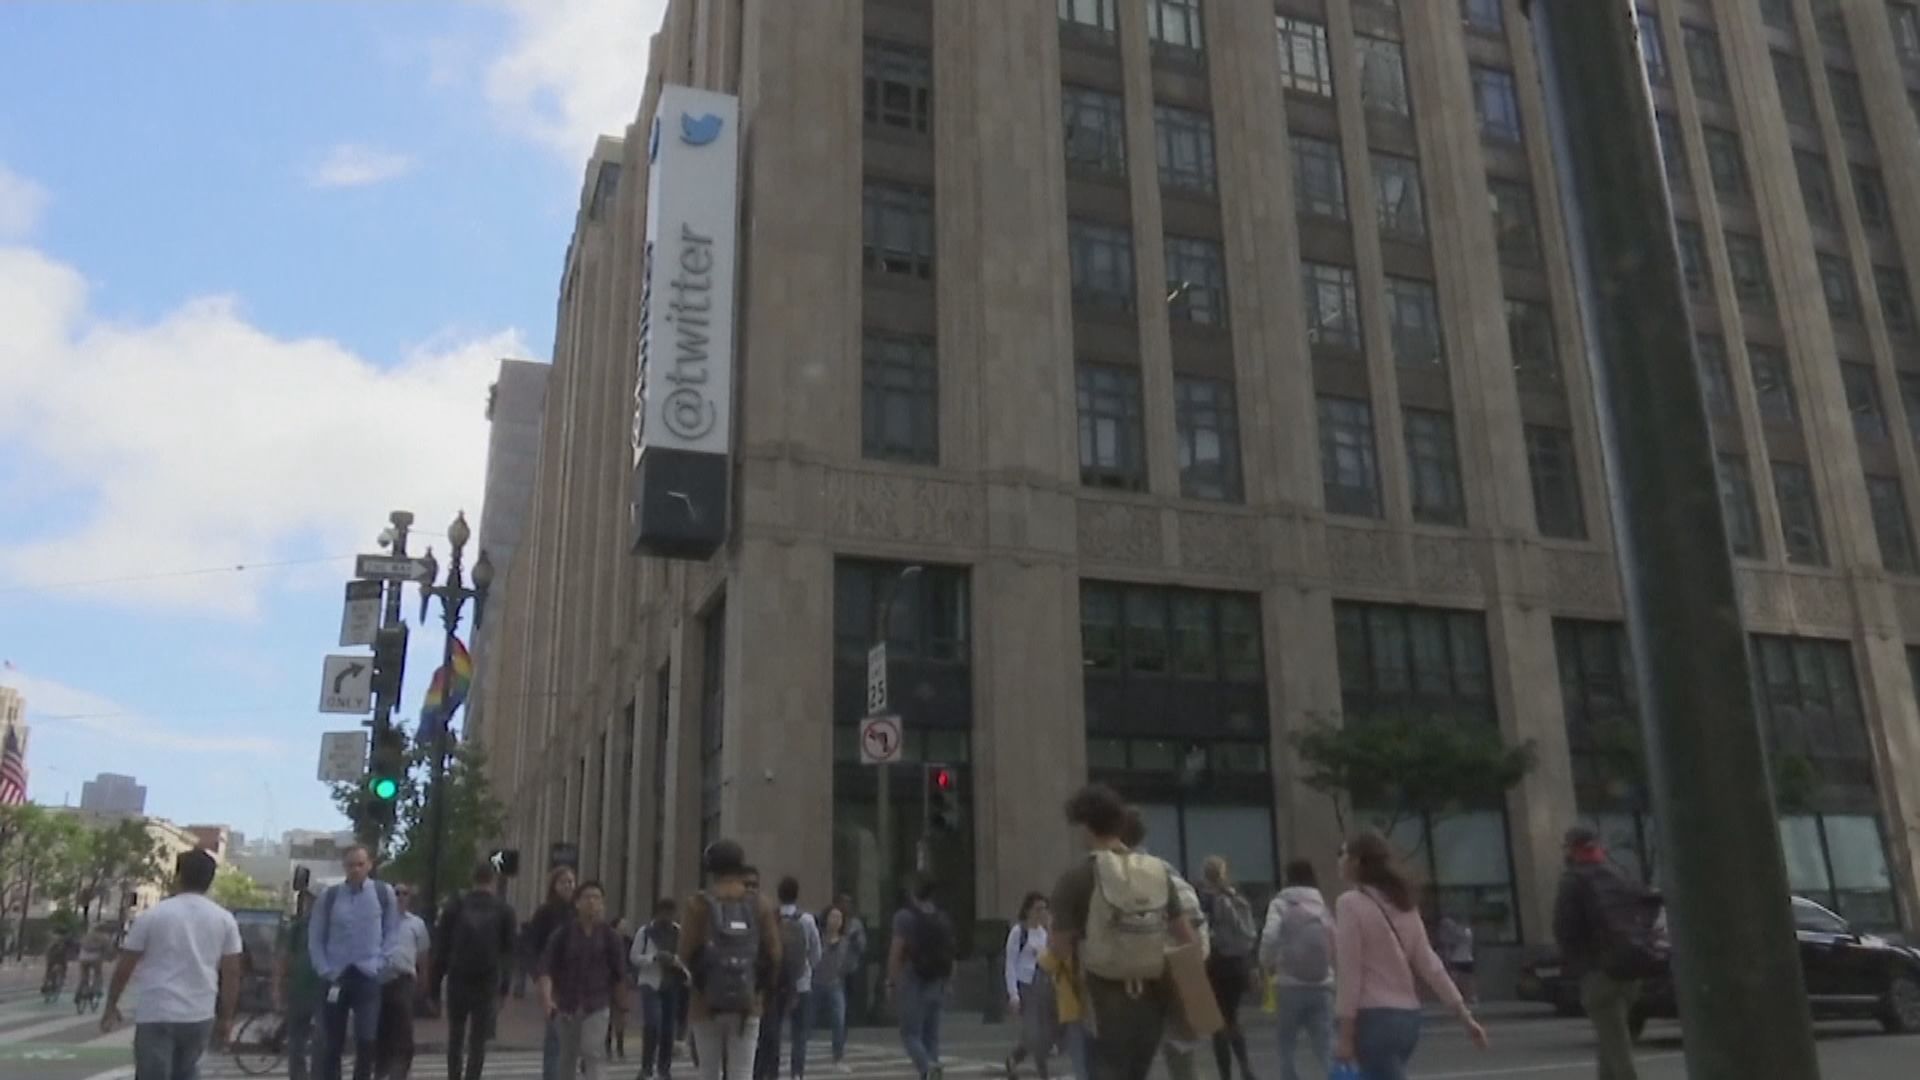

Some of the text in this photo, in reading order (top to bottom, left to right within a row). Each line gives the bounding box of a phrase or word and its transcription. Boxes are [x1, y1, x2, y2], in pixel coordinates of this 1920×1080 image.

[662, 222, 717, 440] @twitter
[326, 695, 364, 709] ONLY
[869, 679, 885, 709] 25
